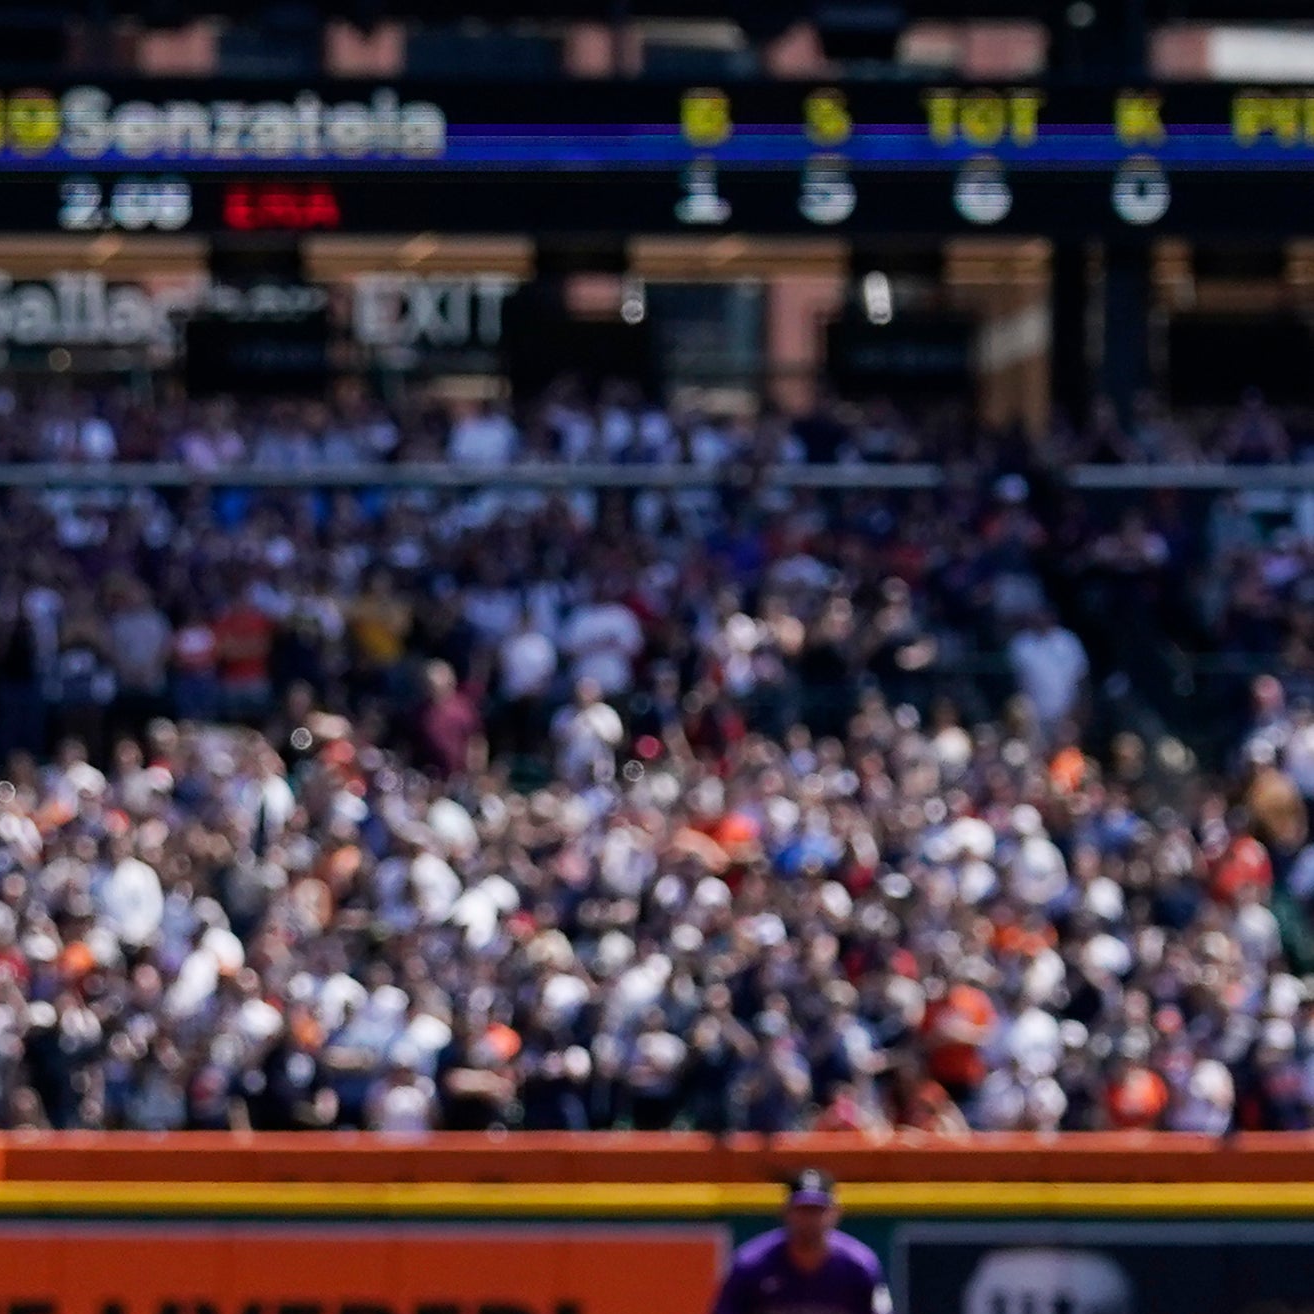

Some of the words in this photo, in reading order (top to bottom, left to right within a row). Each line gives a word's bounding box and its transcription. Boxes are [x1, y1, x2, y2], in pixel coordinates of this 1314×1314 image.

[679, 87, 732, 147] B
[803, 87, 854, 147] S
[920, 87, 1045, 148] TOT
[1114, 88, 1167, 147] K
[1112, 154, 1172, 225] 0
